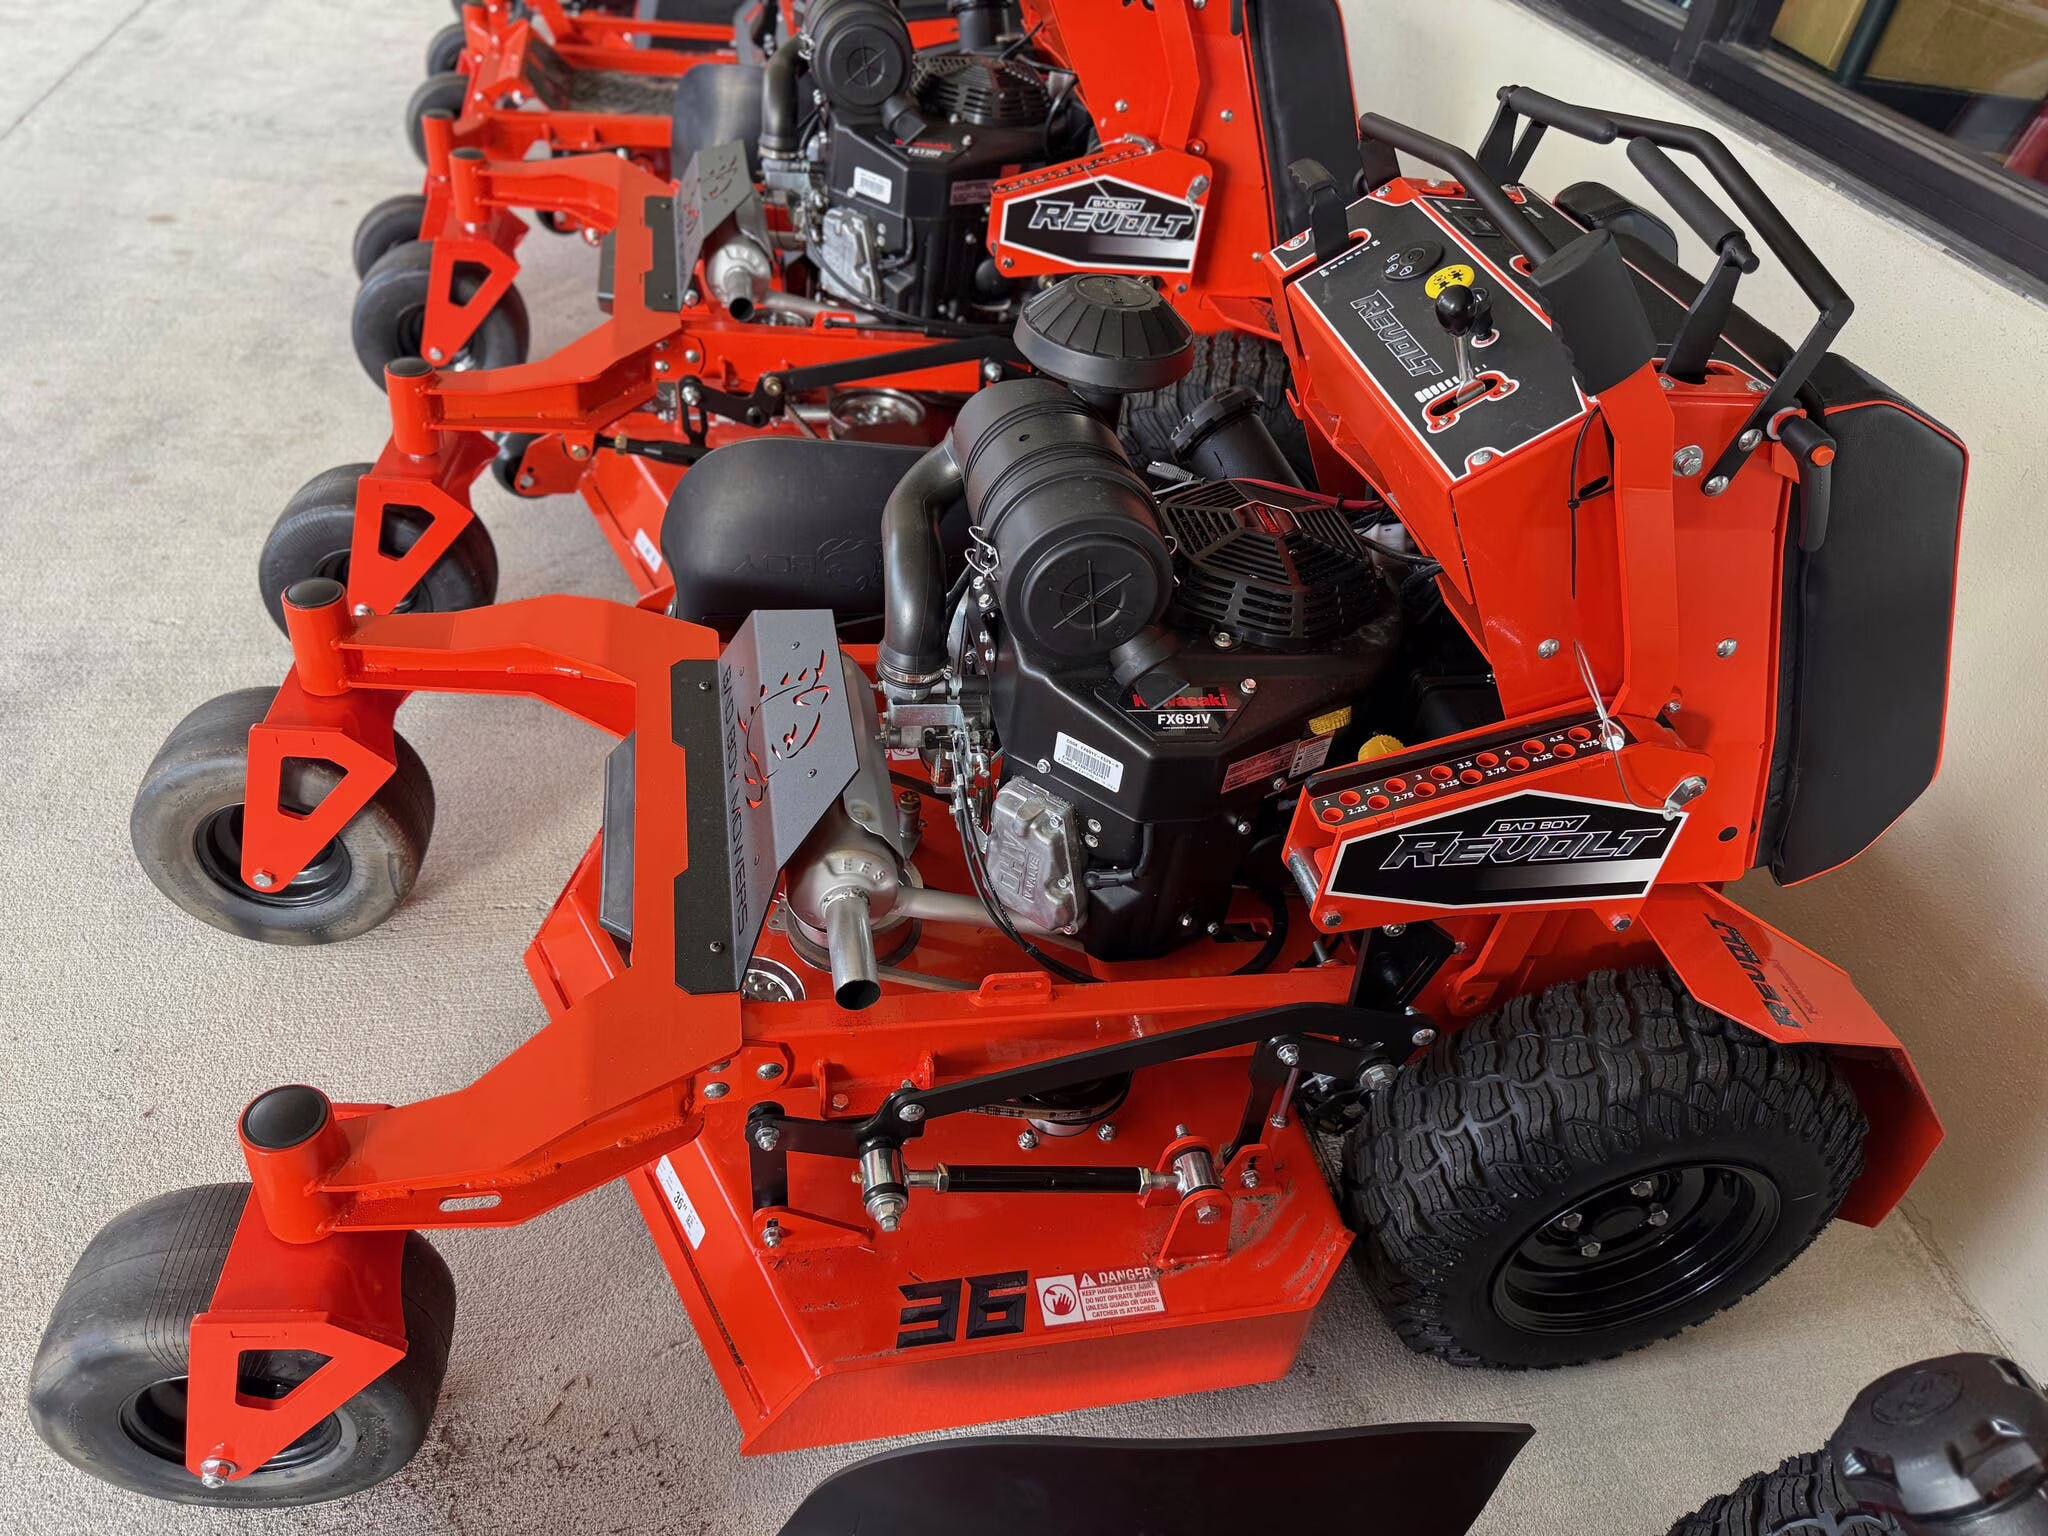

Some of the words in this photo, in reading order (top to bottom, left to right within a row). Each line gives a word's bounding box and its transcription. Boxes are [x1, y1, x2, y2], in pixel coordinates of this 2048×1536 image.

[1029, 200, 1194, 238] REVOLT
[1350, 290, 1443, 377] REVOLT
[723, 664, 735, 724] BAD
[1158, 714, 1211, 725] FX691V
[726, 725, 738, 783] BOY
[1364, 787, 1380, 795] 2.5
[1457, 760, 1473, 769] 3.5
[1549, 735, 1564, 743] 4.5
[1347, 804, 1368, 815] 2.25
[1393, 791, 1414, 802] 2.75
[1439, 779, 1460, 790] 3.25
[1485, 766, 1507, 777] 3.75
[1532, 752, 1553, 763] 4.25
[1579, 739, 1600, 749] 4.75
[1498, 822, 1535, 832] BAD
[1539, 820, 1577, 830] BOY
[731, 784, 748, 935] MOWERS
[1379, 828, 1666, 870] REVOLT
[1703, 913, 1803, 1028] REVOLT
[1082, 1289, 1096, 1297] KEEP
[1098, 1287, 1117, 1295] HANDS
[1099, 1267, 1152, 1284] DANGER
[1107, 1293, 1133, 1302] OPERATE
[1134, 1290, 1157, 1298] MOWER
[896, 1270, 1029, 1349] 36
[1086, 1303, 1109, 1311] UNLESS
[1109, 1300, 1130, 1309] GUARD
[1139, 1296, 1160, 1305] GRASS
[1091, 1309, 1119, 1318] CATCHER
[1126, 1304, 1158, 1314] ATTACHED.
